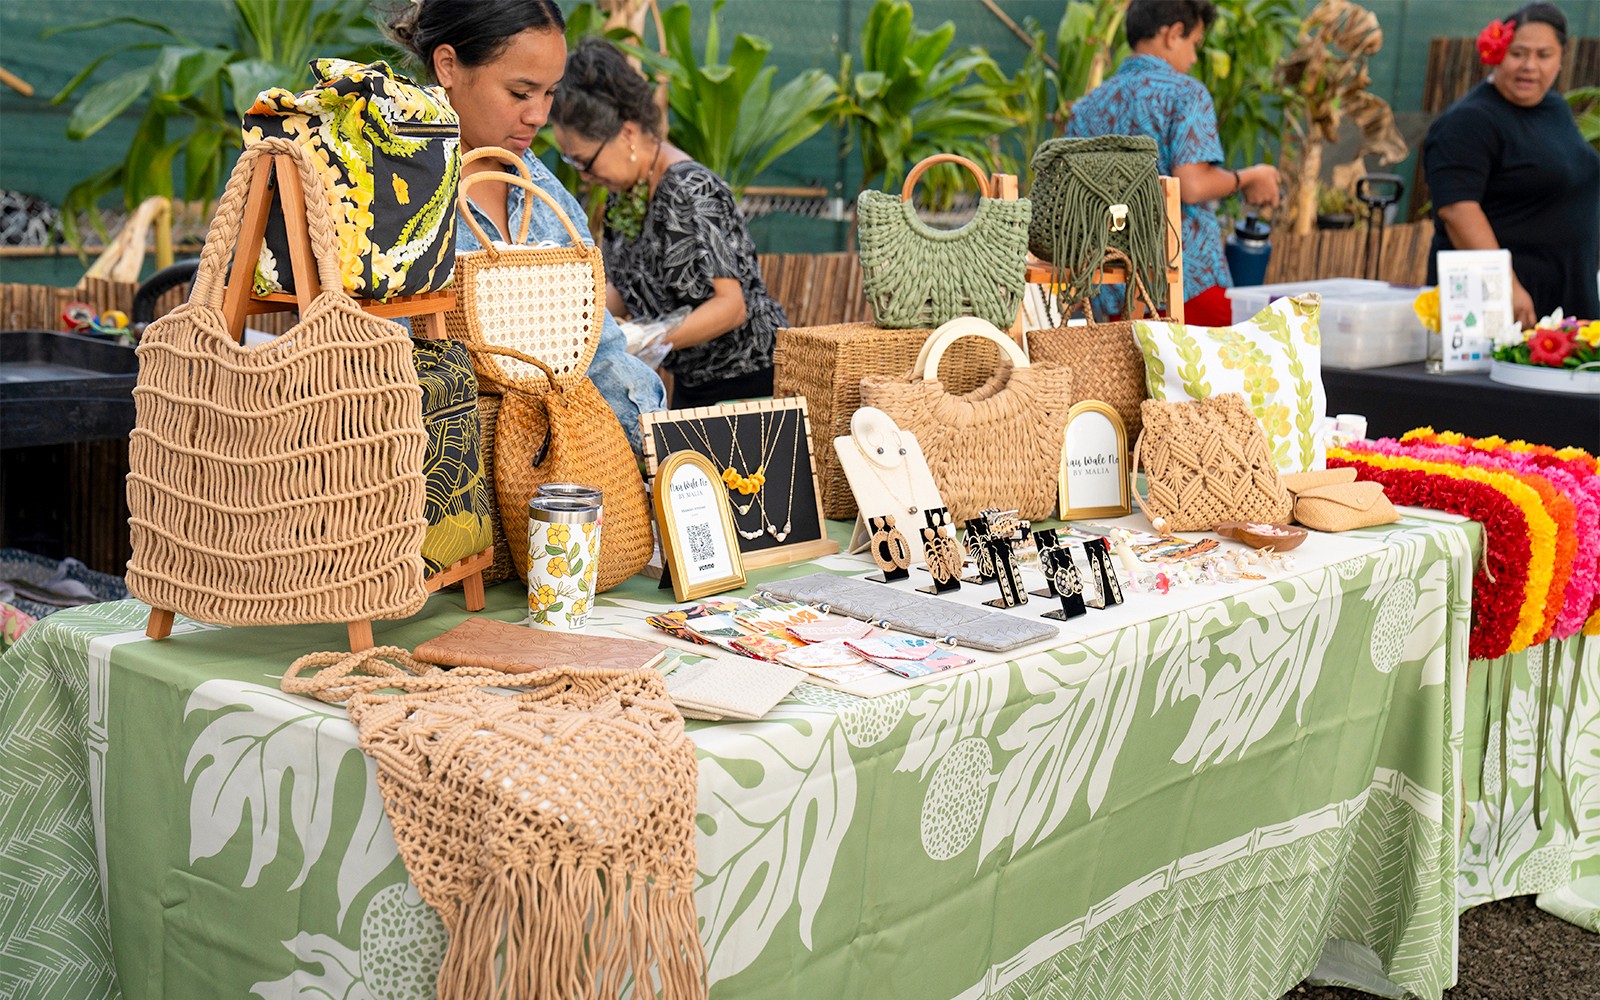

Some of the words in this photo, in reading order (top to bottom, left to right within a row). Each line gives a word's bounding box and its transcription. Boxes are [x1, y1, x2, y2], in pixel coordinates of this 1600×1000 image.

[1084, 454, 1105, 466] Wale
[1086, 467, 1110, 475] MALIA
[686, 490, 704, 498] MALIA
[698, 562, 714, 571] venmo
